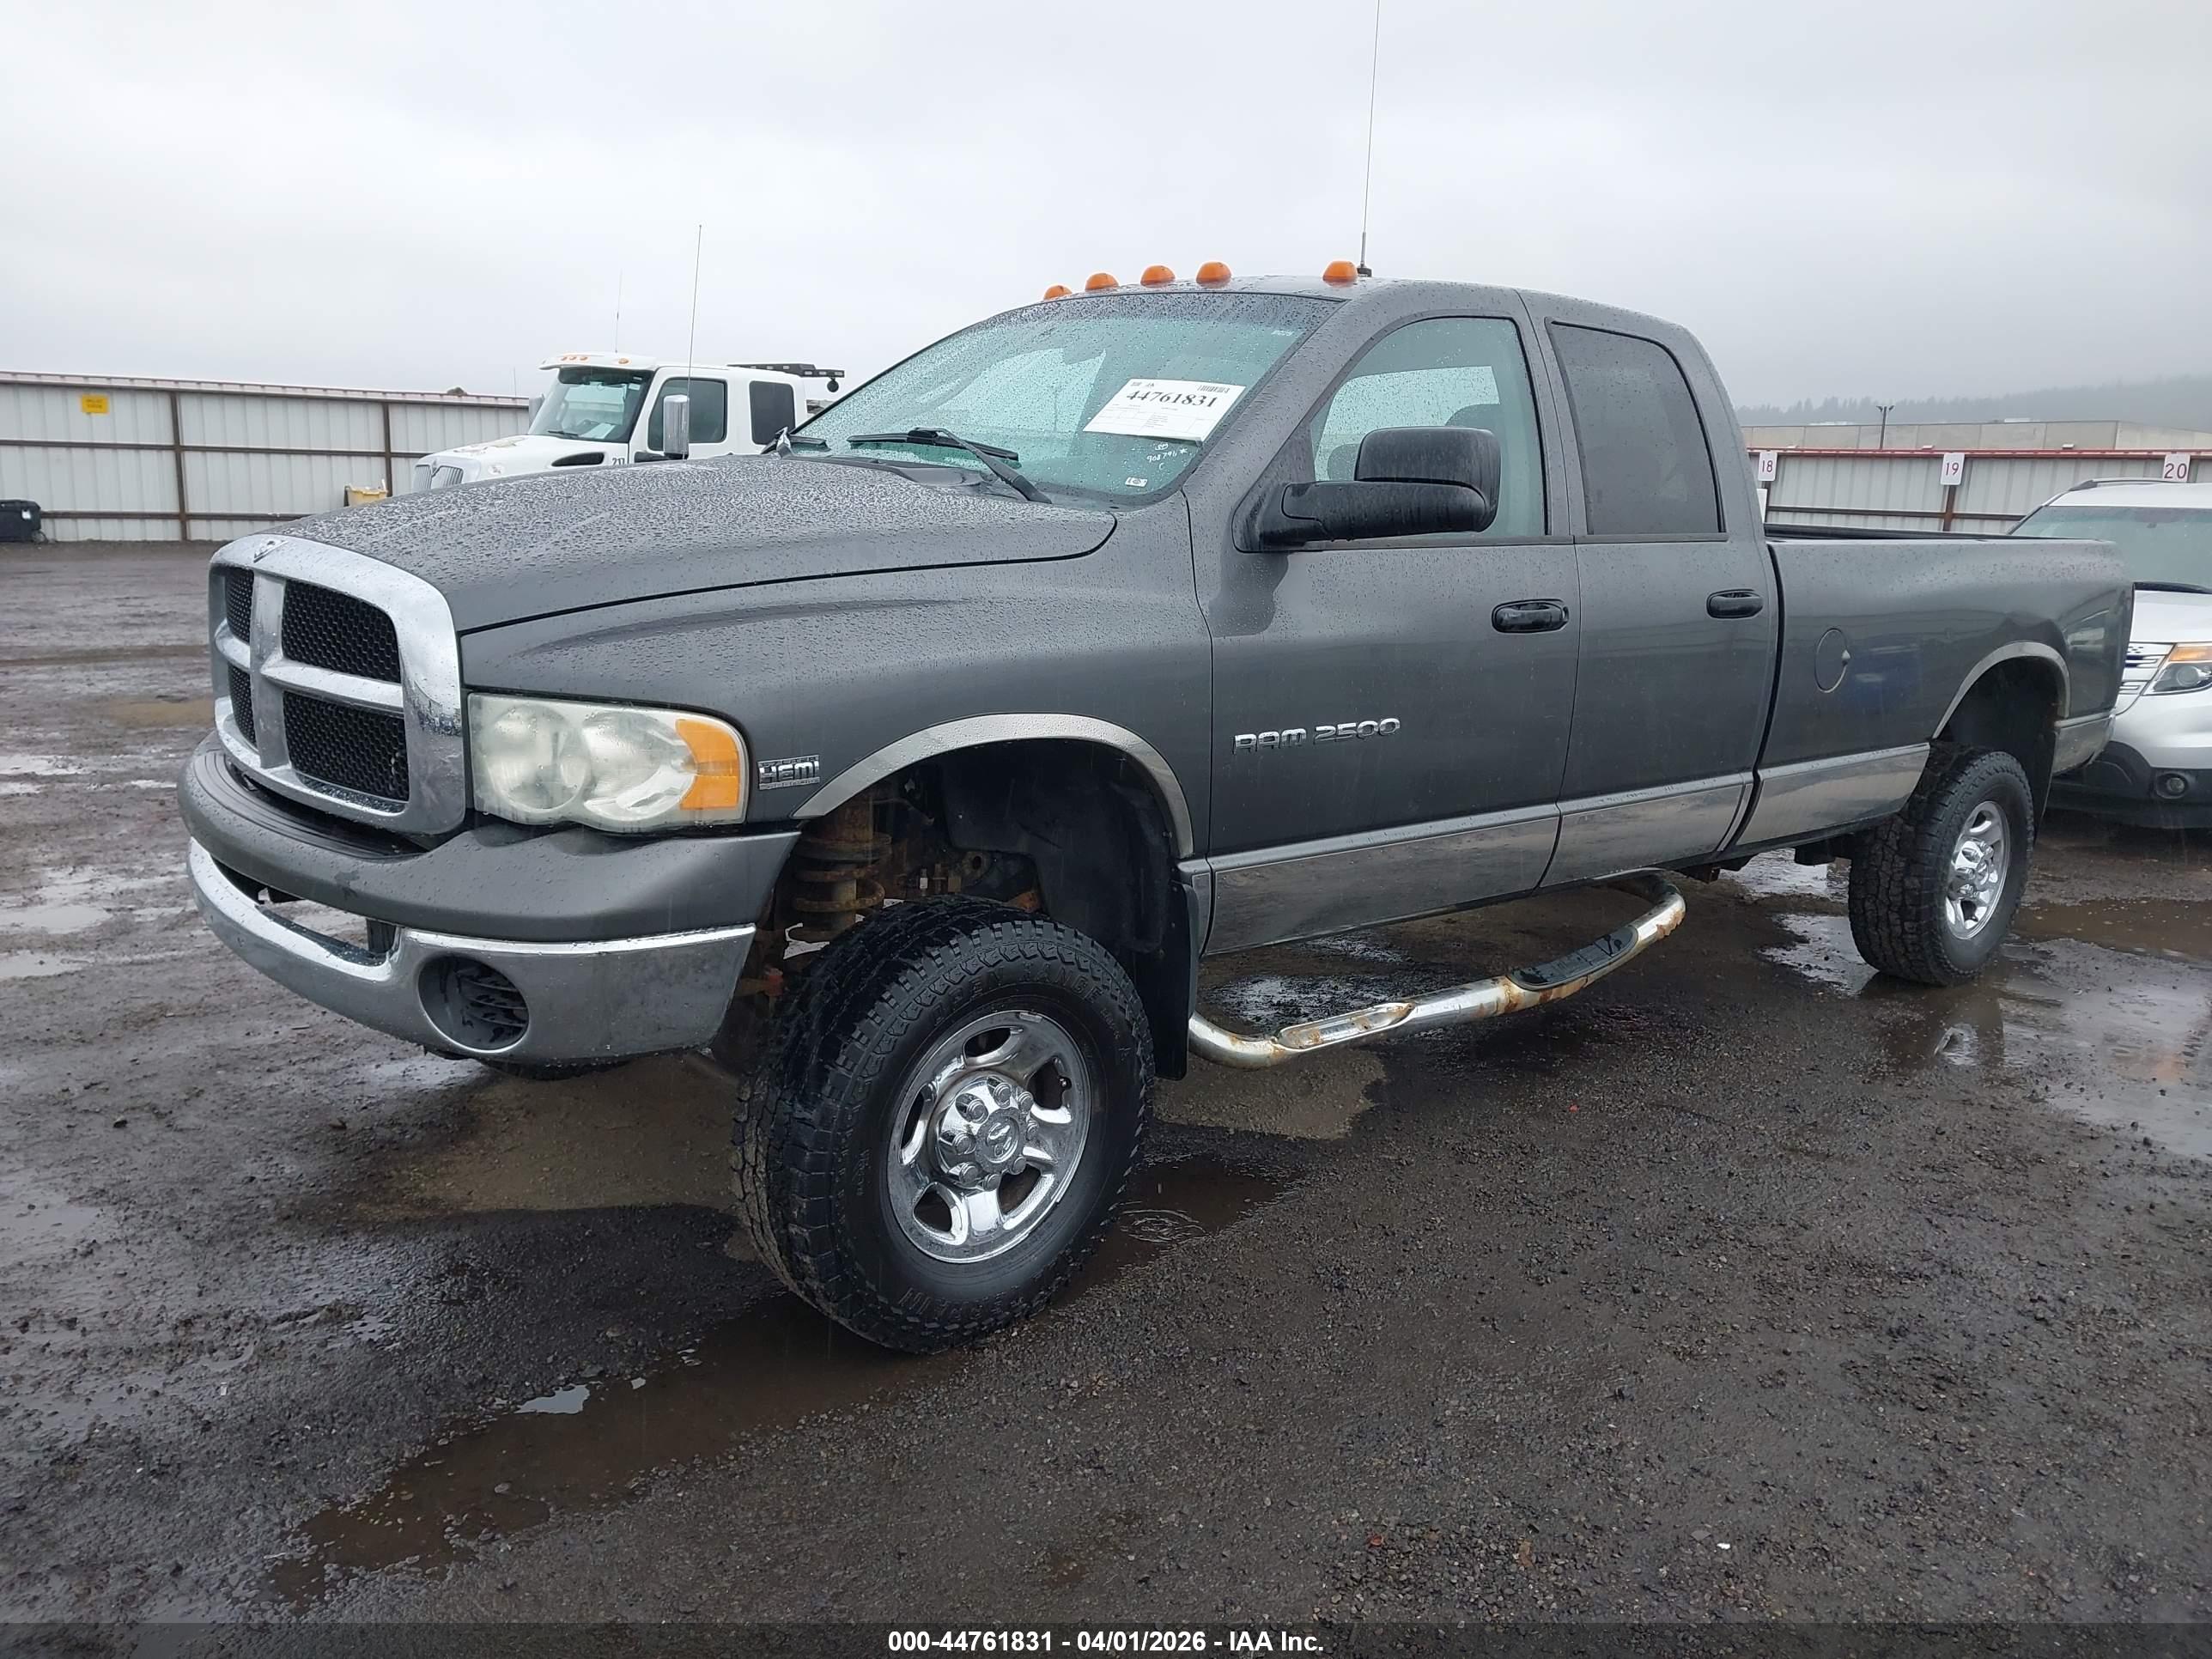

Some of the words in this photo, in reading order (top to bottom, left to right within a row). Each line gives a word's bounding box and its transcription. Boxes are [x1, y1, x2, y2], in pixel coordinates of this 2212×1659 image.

[1126, 390, 1218, 408] 44761831
[1762, 459, 1773, 473] 18
[1945, 462, 1960, 476] 19
[2164, 463, 2188, 479] 20
[1233, 727, 1307, 752] RAM
[1314, 717, 1401, 744] 2500
[758, 760, 820, 785] HEMI
